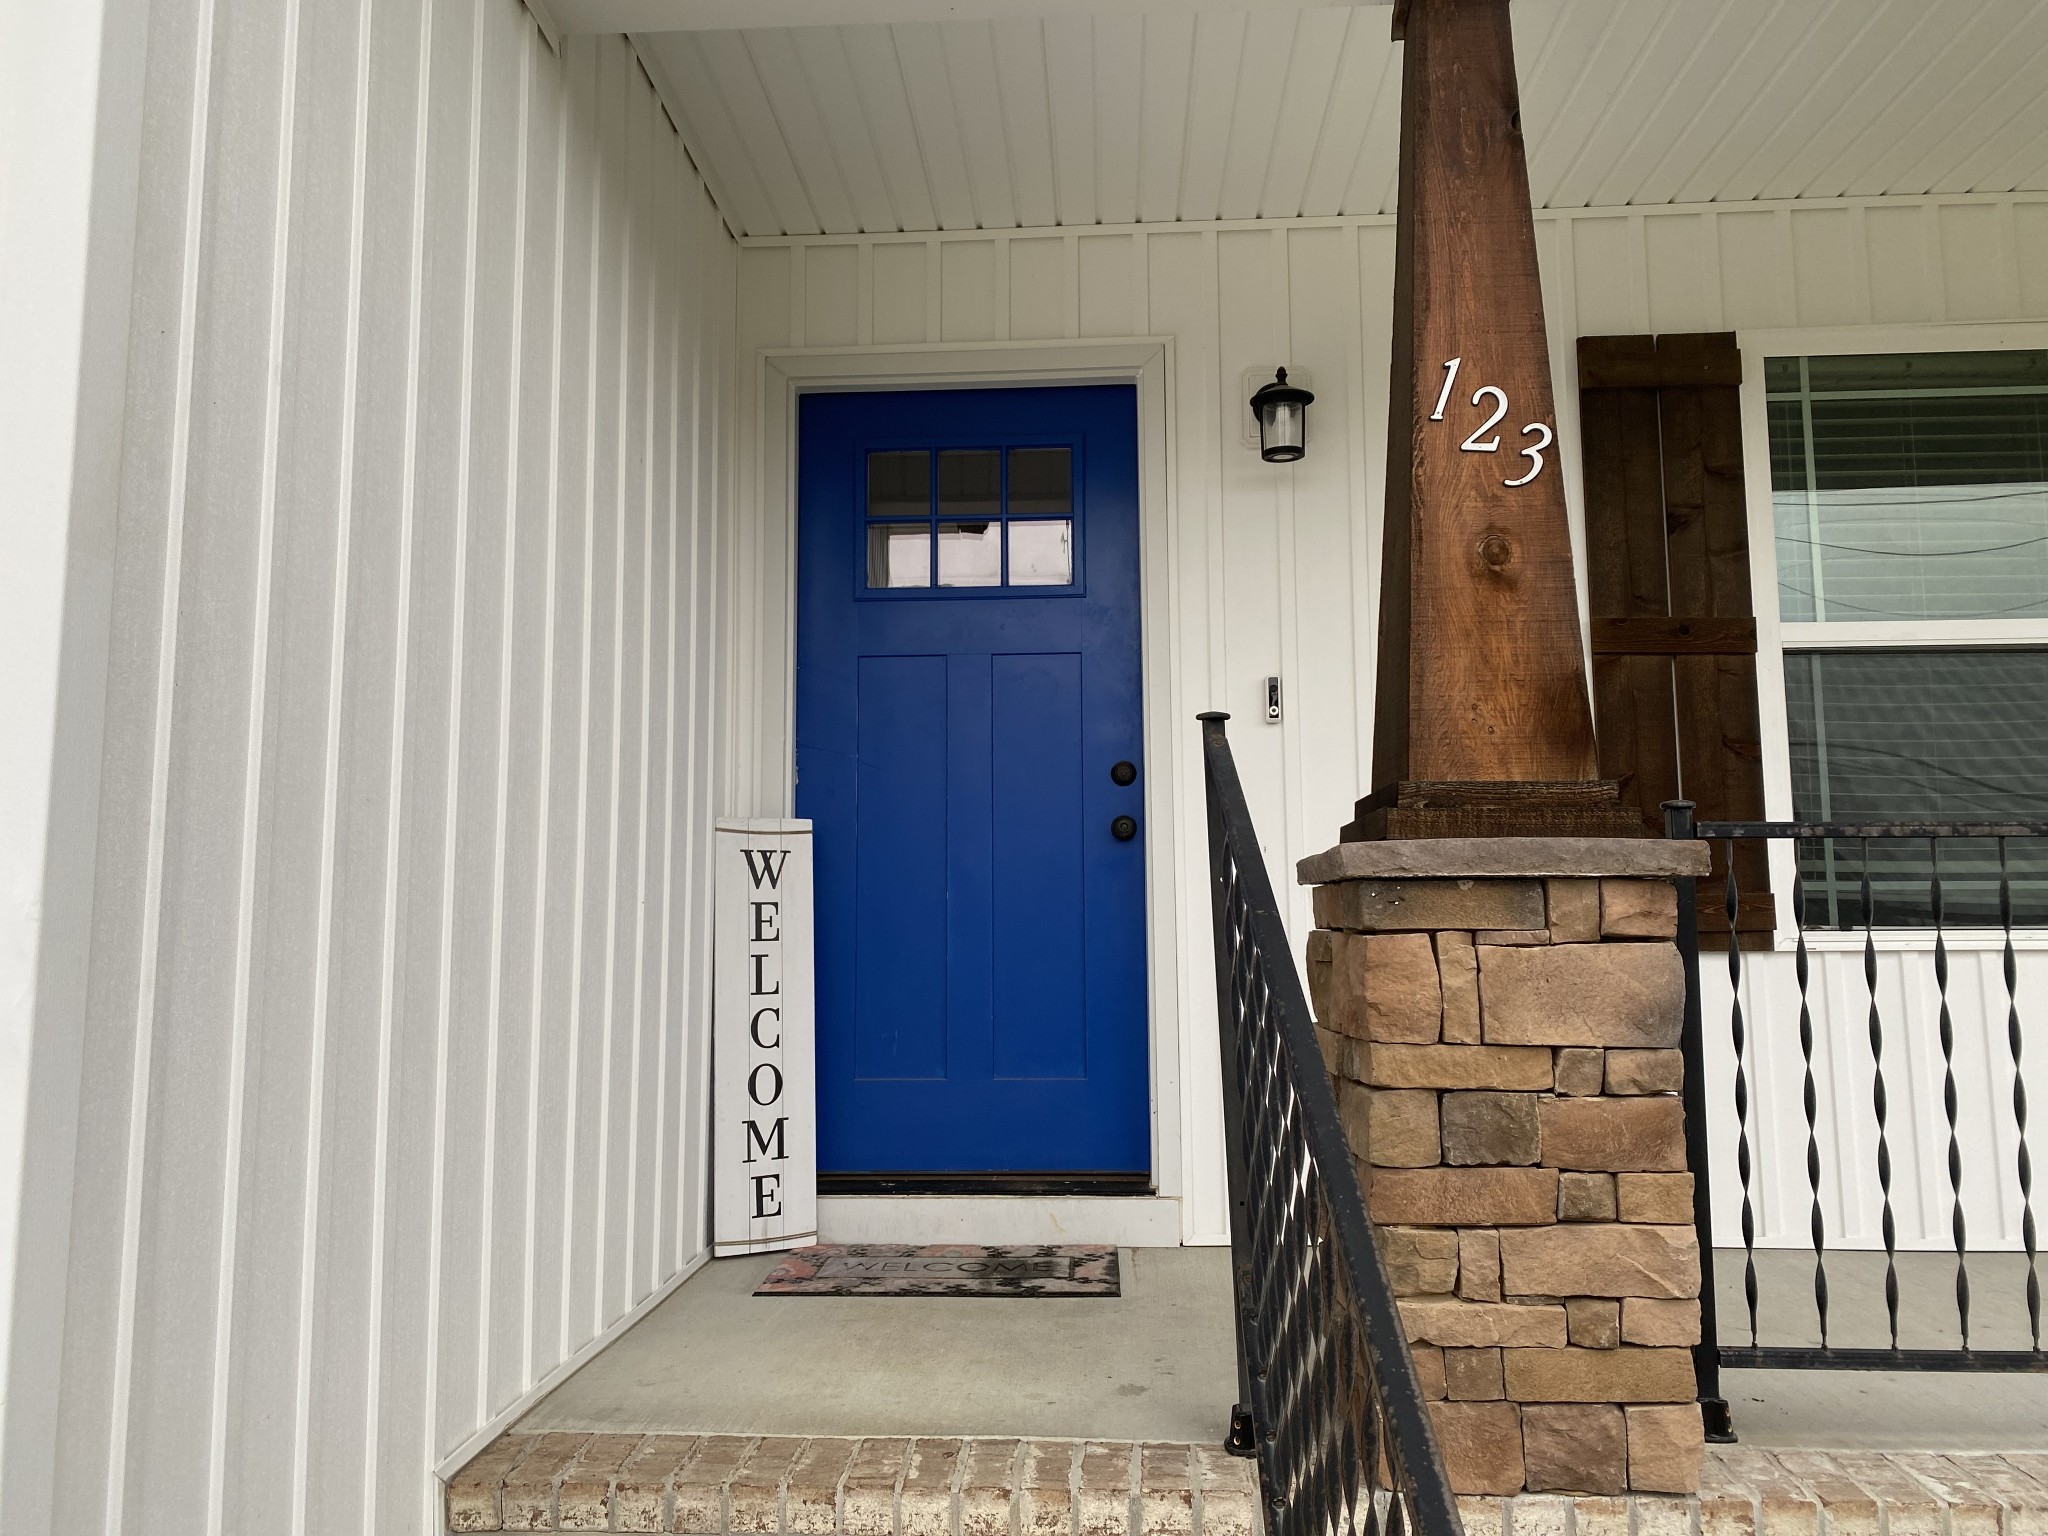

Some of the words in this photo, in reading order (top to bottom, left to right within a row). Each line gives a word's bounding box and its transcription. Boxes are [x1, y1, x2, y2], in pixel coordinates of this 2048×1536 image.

[1429, 357, 1553, 487] 123
[740, 849, 791, 1219] WELCOME
[843, 1261, 1049, 1272] WELCOME
